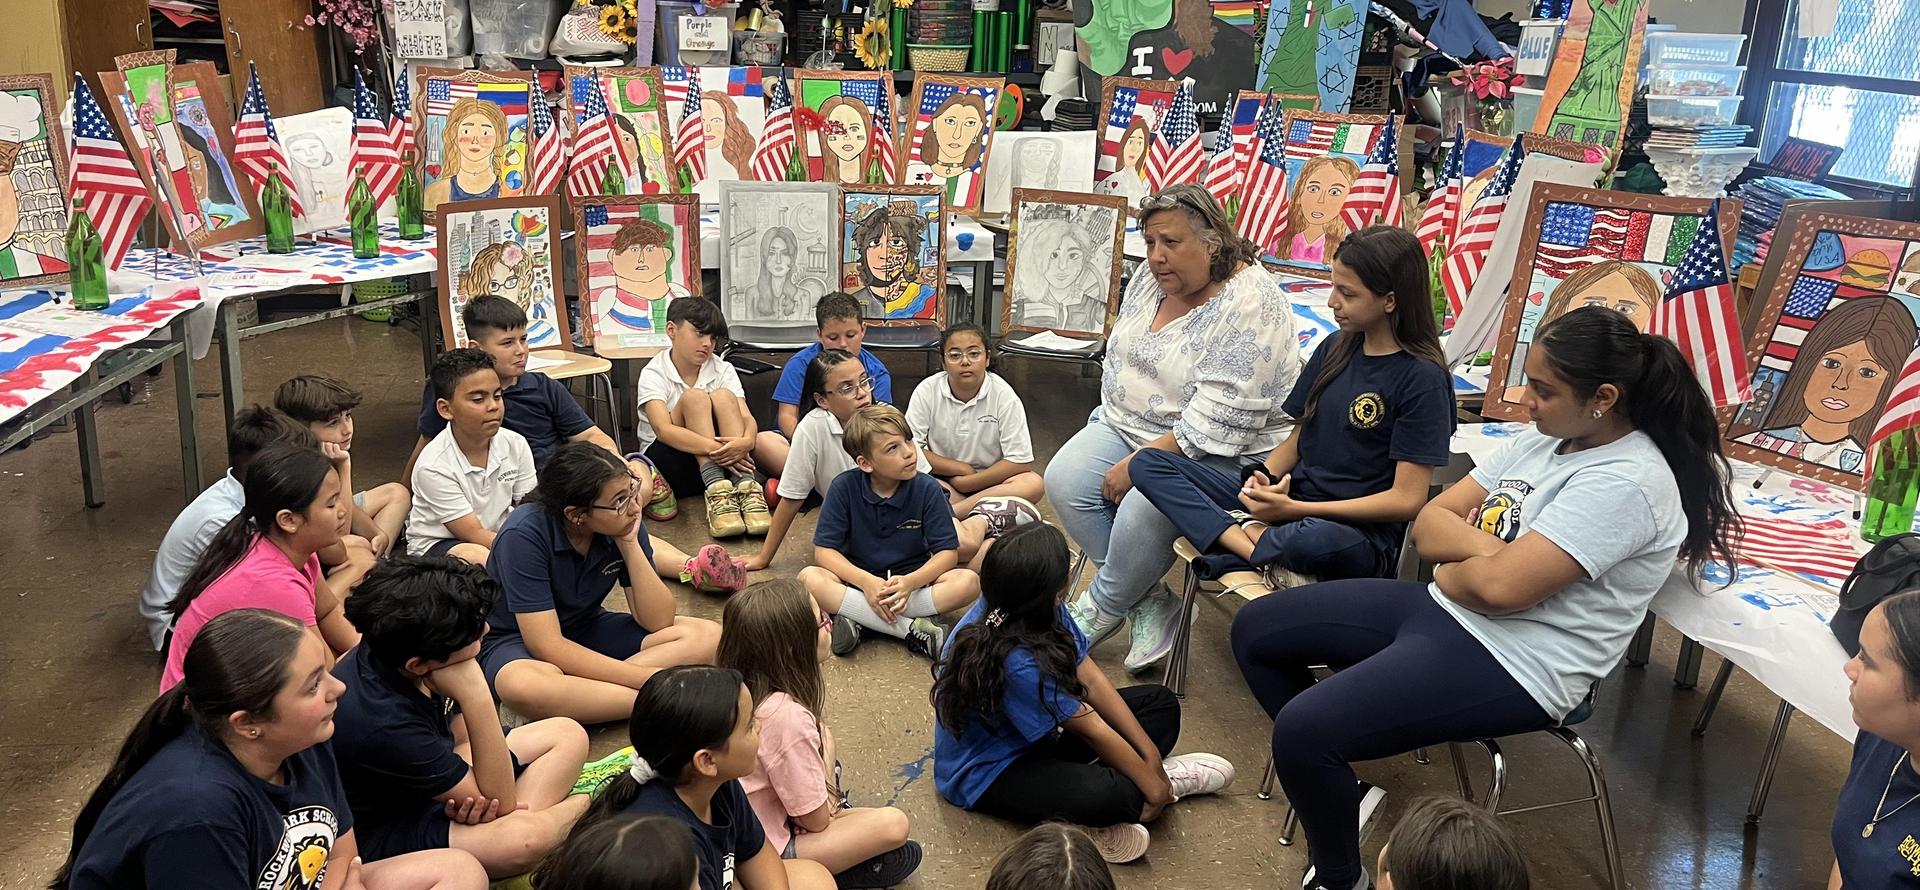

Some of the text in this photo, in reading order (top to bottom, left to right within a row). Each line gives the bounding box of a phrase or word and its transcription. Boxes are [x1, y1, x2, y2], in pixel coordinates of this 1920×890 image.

[398, 0, 443, 22] BLACK
[686, 18, 712, 33] Purple
[686, 38, 715, 49] Orange
[1520, 36, 1551, 60] BLUE
[1131, 46, 1153, 76] I
[1770, 141, 1833, 177] IMAGINE
[1815, 252, 1839, 265] USA
